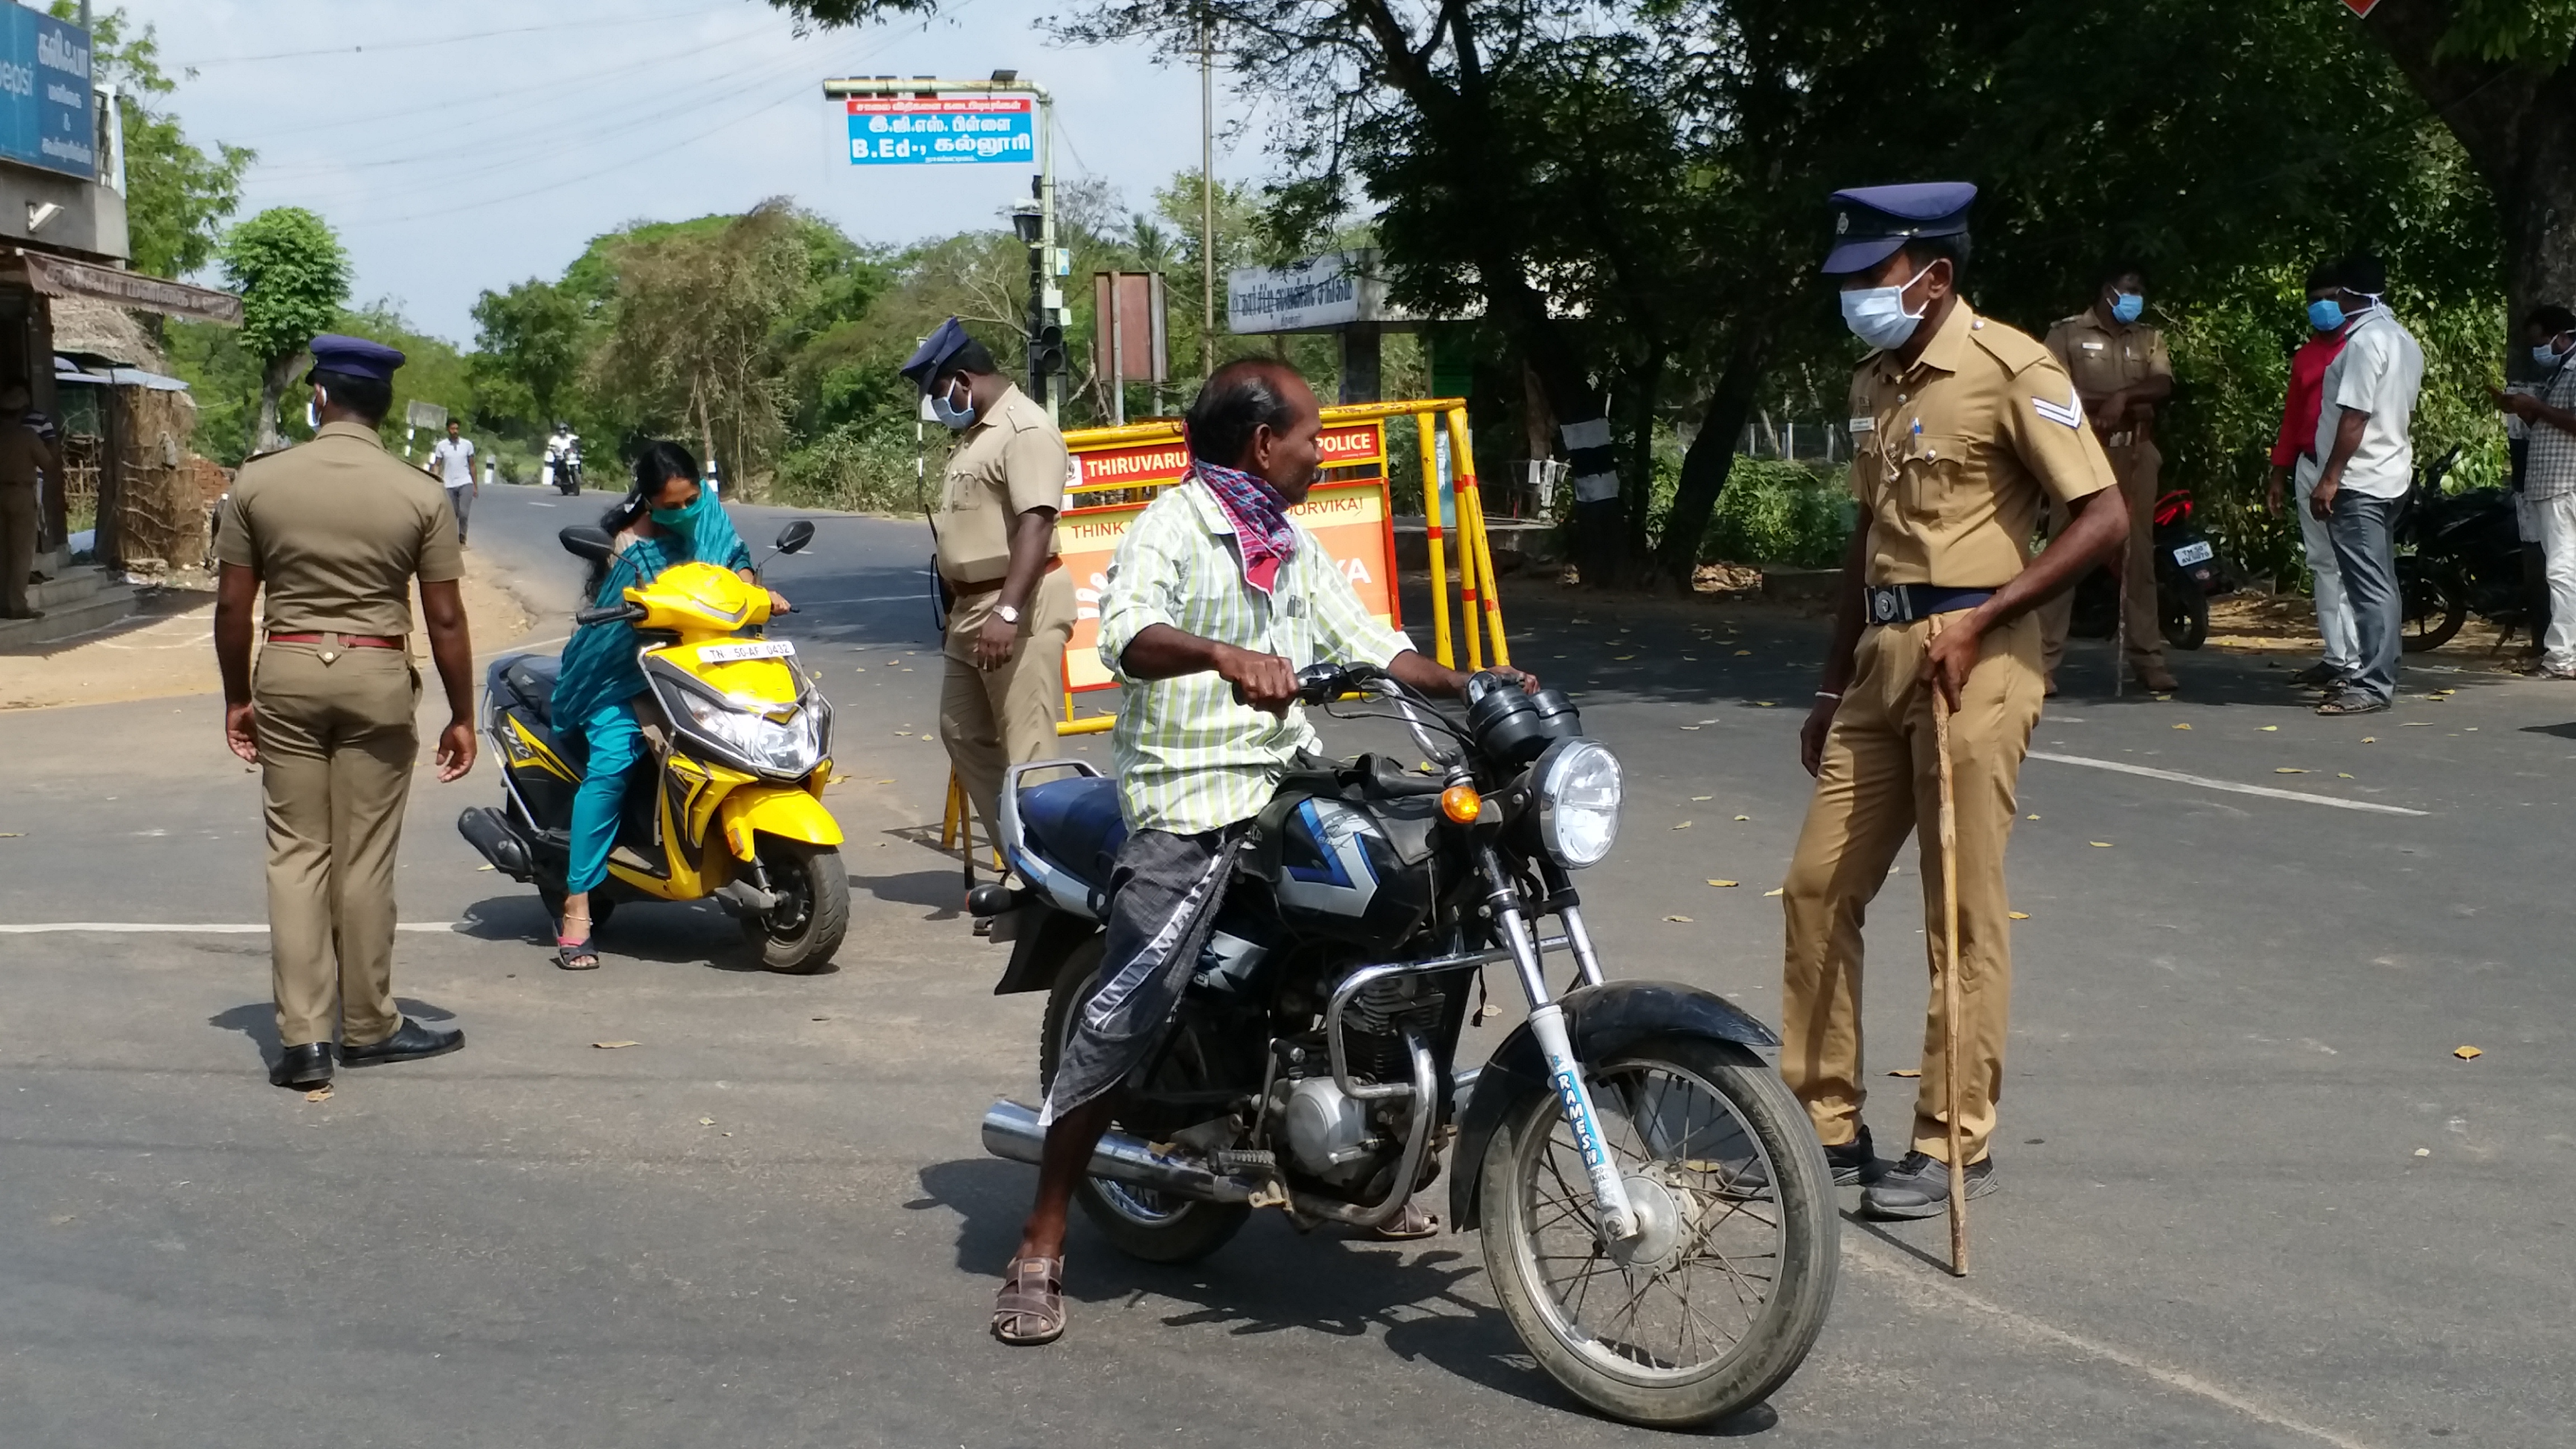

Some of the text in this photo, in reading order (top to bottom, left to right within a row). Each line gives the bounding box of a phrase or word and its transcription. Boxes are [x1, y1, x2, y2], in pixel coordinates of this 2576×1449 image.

[0, 60, 33, 101] epsi
[952, 115, 1011, 132] பிள்ளை
[934, 133, 1031, 157] கல்லூரி
[1087, 451, 1188, 477] THIRUVARU
[1072, 521, 1125, 538] THINK
[766, 644, 790, 655] 0432
[1557, 1074, 1598, 1166] RAMESH
